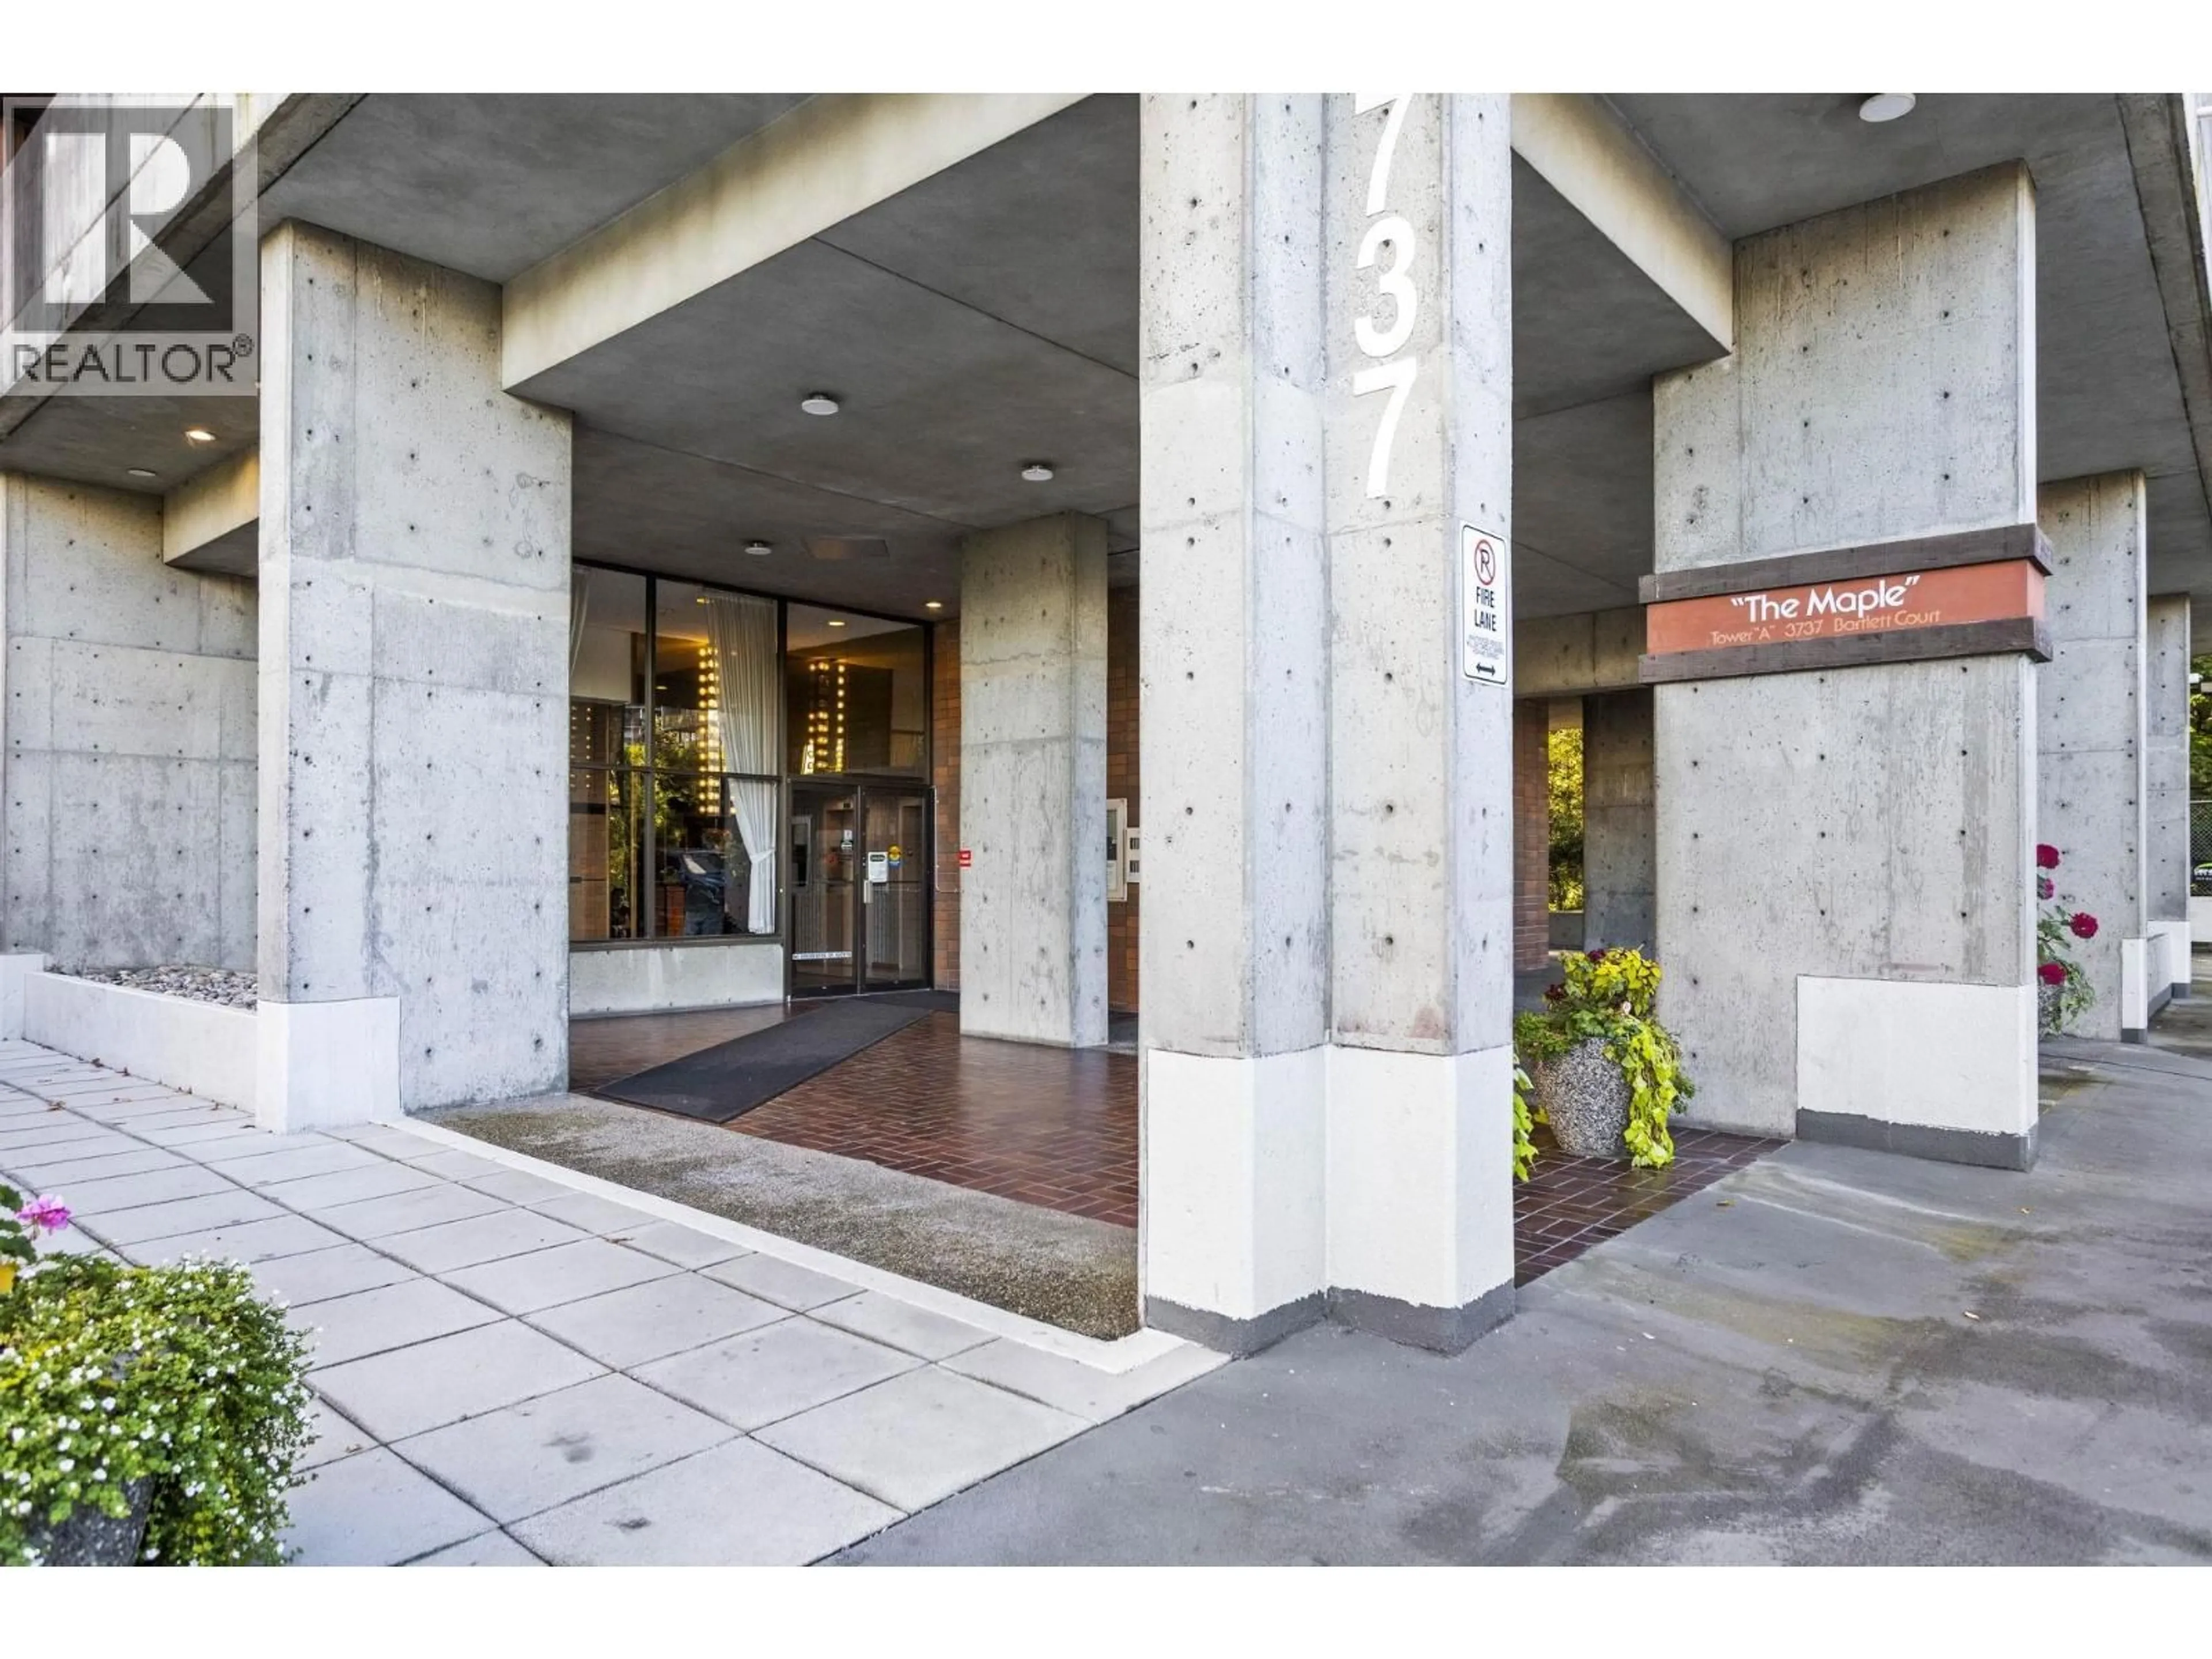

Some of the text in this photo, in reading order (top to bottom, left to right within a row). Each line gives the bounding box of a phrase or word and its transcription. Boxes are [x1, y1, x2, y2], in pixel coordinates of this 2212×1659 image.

[1476, 586, 1495, 608] FIRE
[1474, 608, 1497, 632] LANE
[1710, 630, 1753, 645] Tower
[1784, 619, 1824, 637] 3737
[1834, 615, 1892, 632] Bartlett
[1893, 609, 1941, 626] Court
